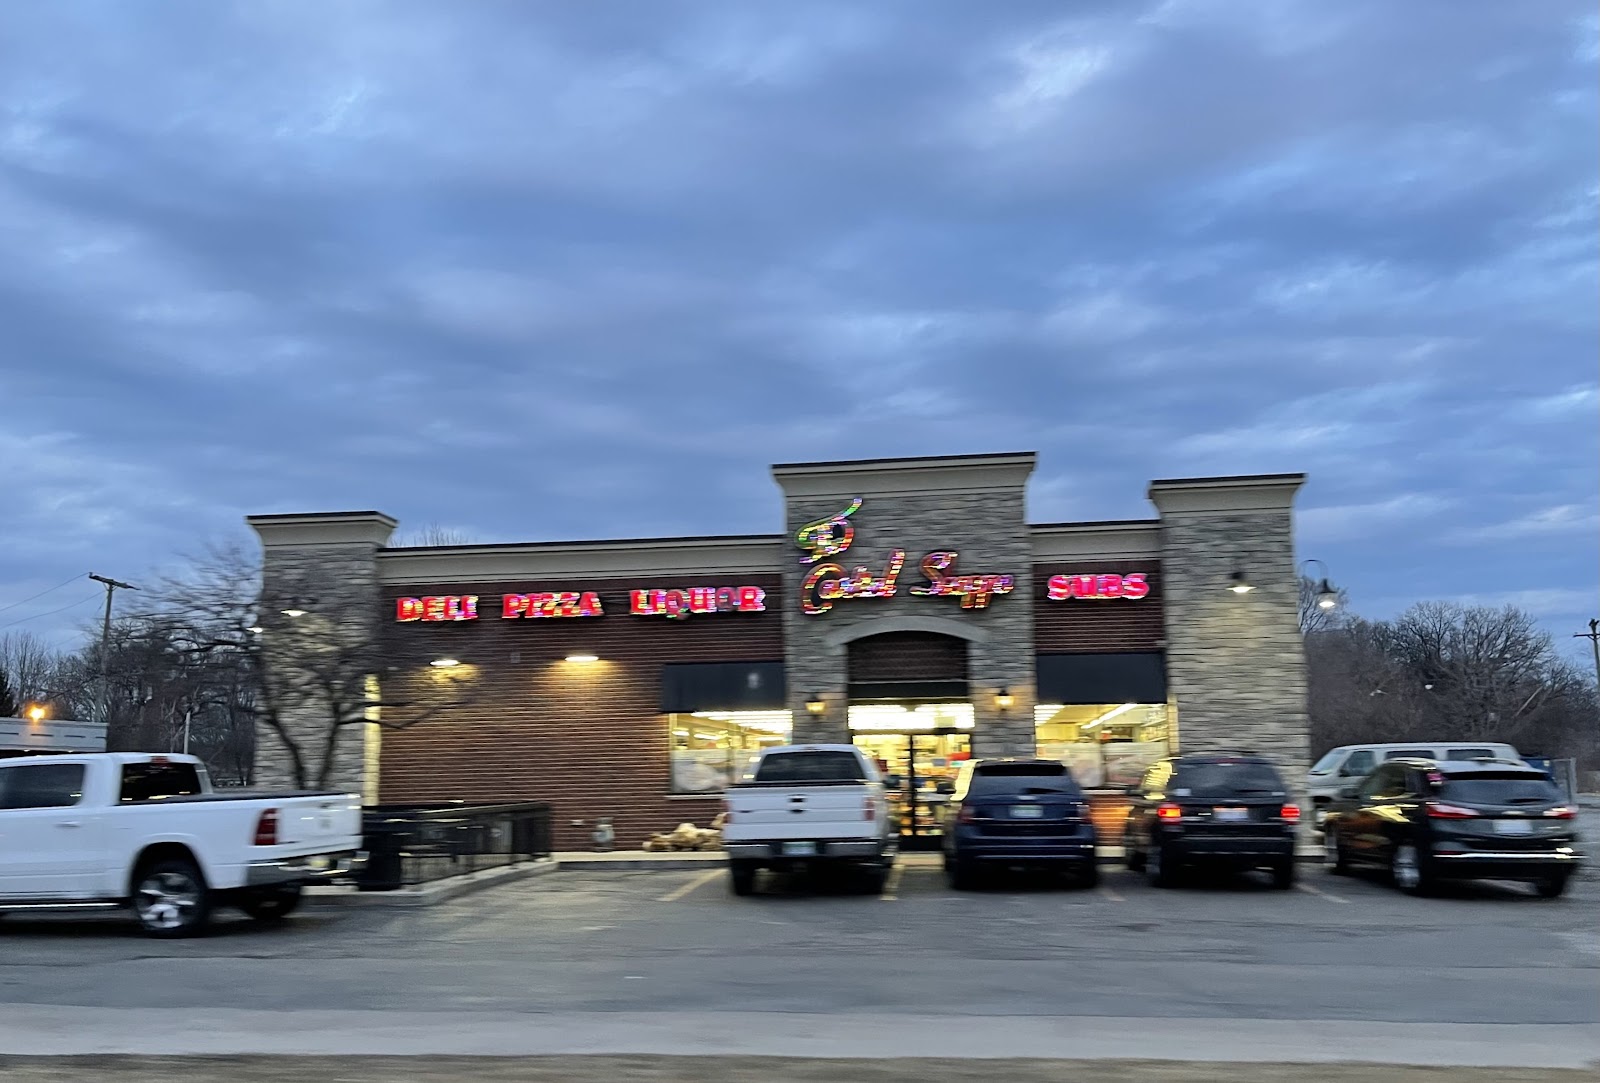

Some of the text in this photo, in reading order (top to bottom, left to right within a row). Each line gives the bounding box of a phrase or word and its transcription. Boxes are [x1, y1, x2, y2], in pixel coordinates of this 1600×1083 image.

[1047, 573, 1150, 600] SUBS
[396, 585, 766, 622] DELI PIZZA LIQUOR
